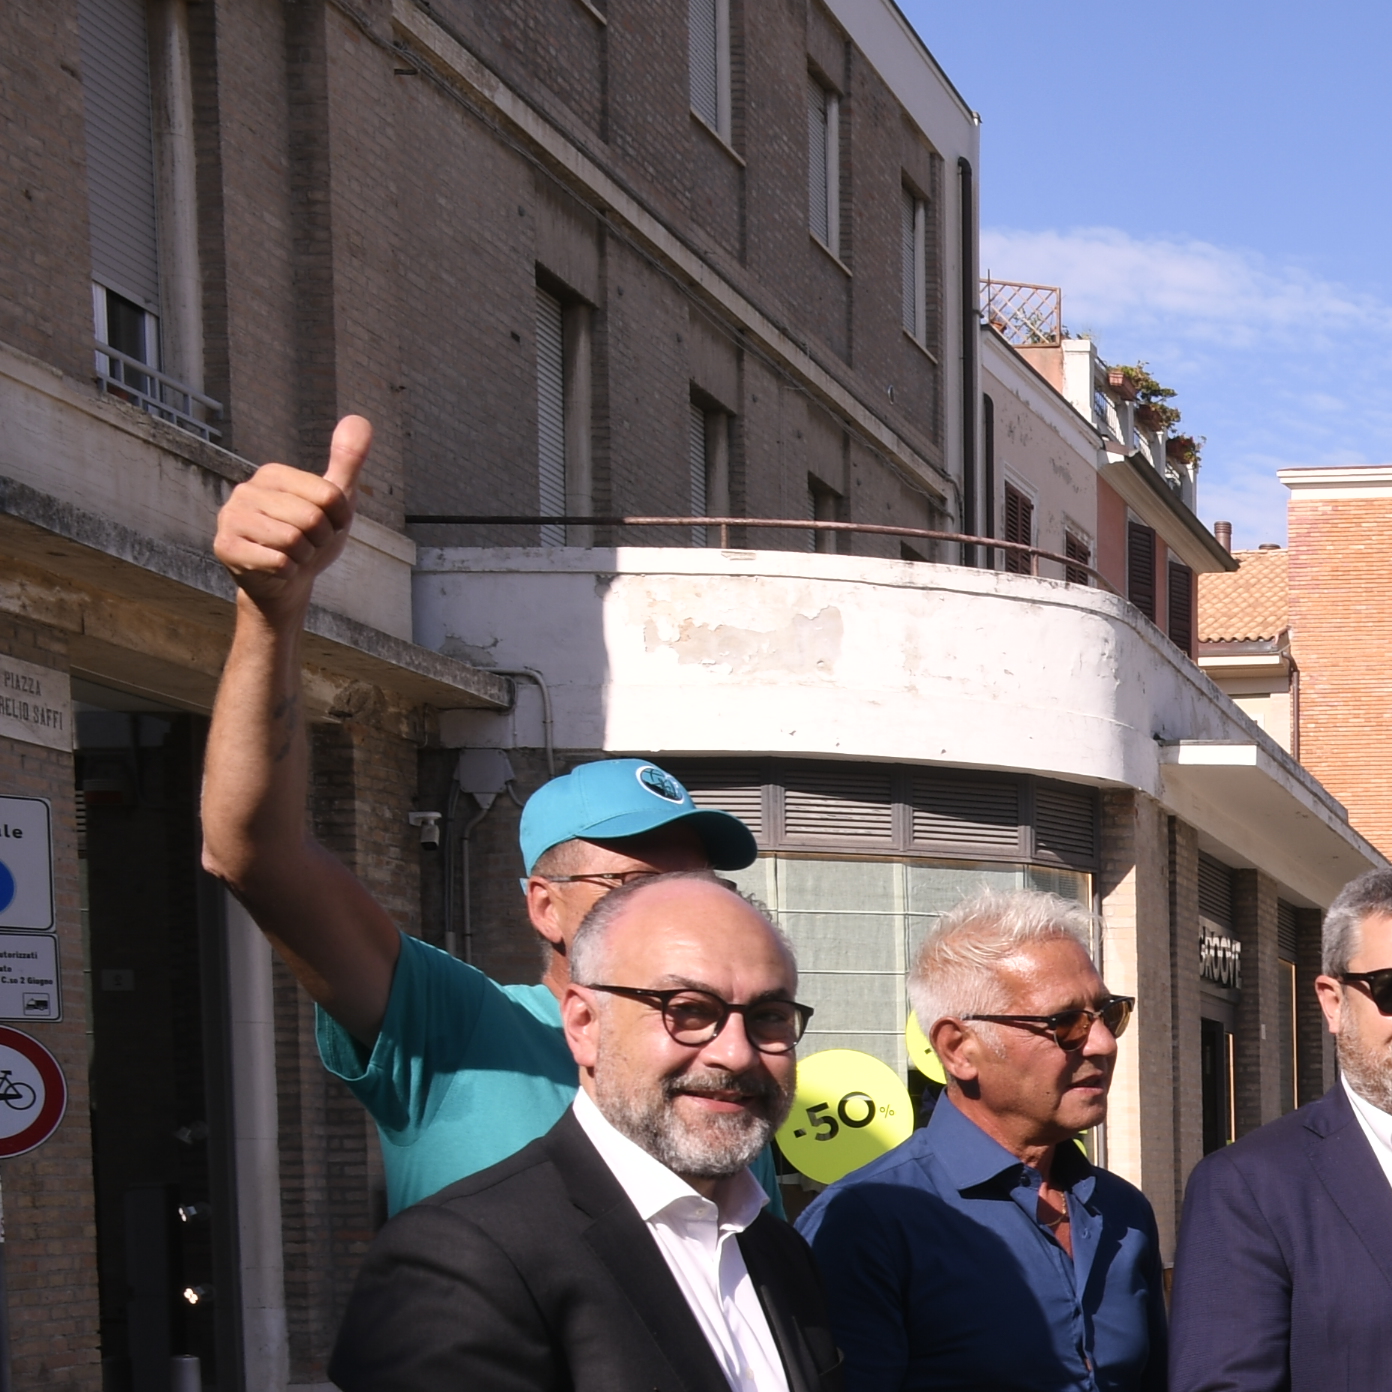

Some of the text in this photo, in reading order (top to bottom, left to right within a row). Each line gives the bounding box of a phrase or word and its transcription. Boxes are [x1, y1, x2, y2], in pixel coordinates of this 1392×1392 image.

[4, 670, 41, 696] PIAZZA
[33, 704, 62, 730] SAFFI
[0, 824, 24, 838] le
[1200, 926, 1242, 989] GROOVE
[28, 977, 54, 986] Giugno
